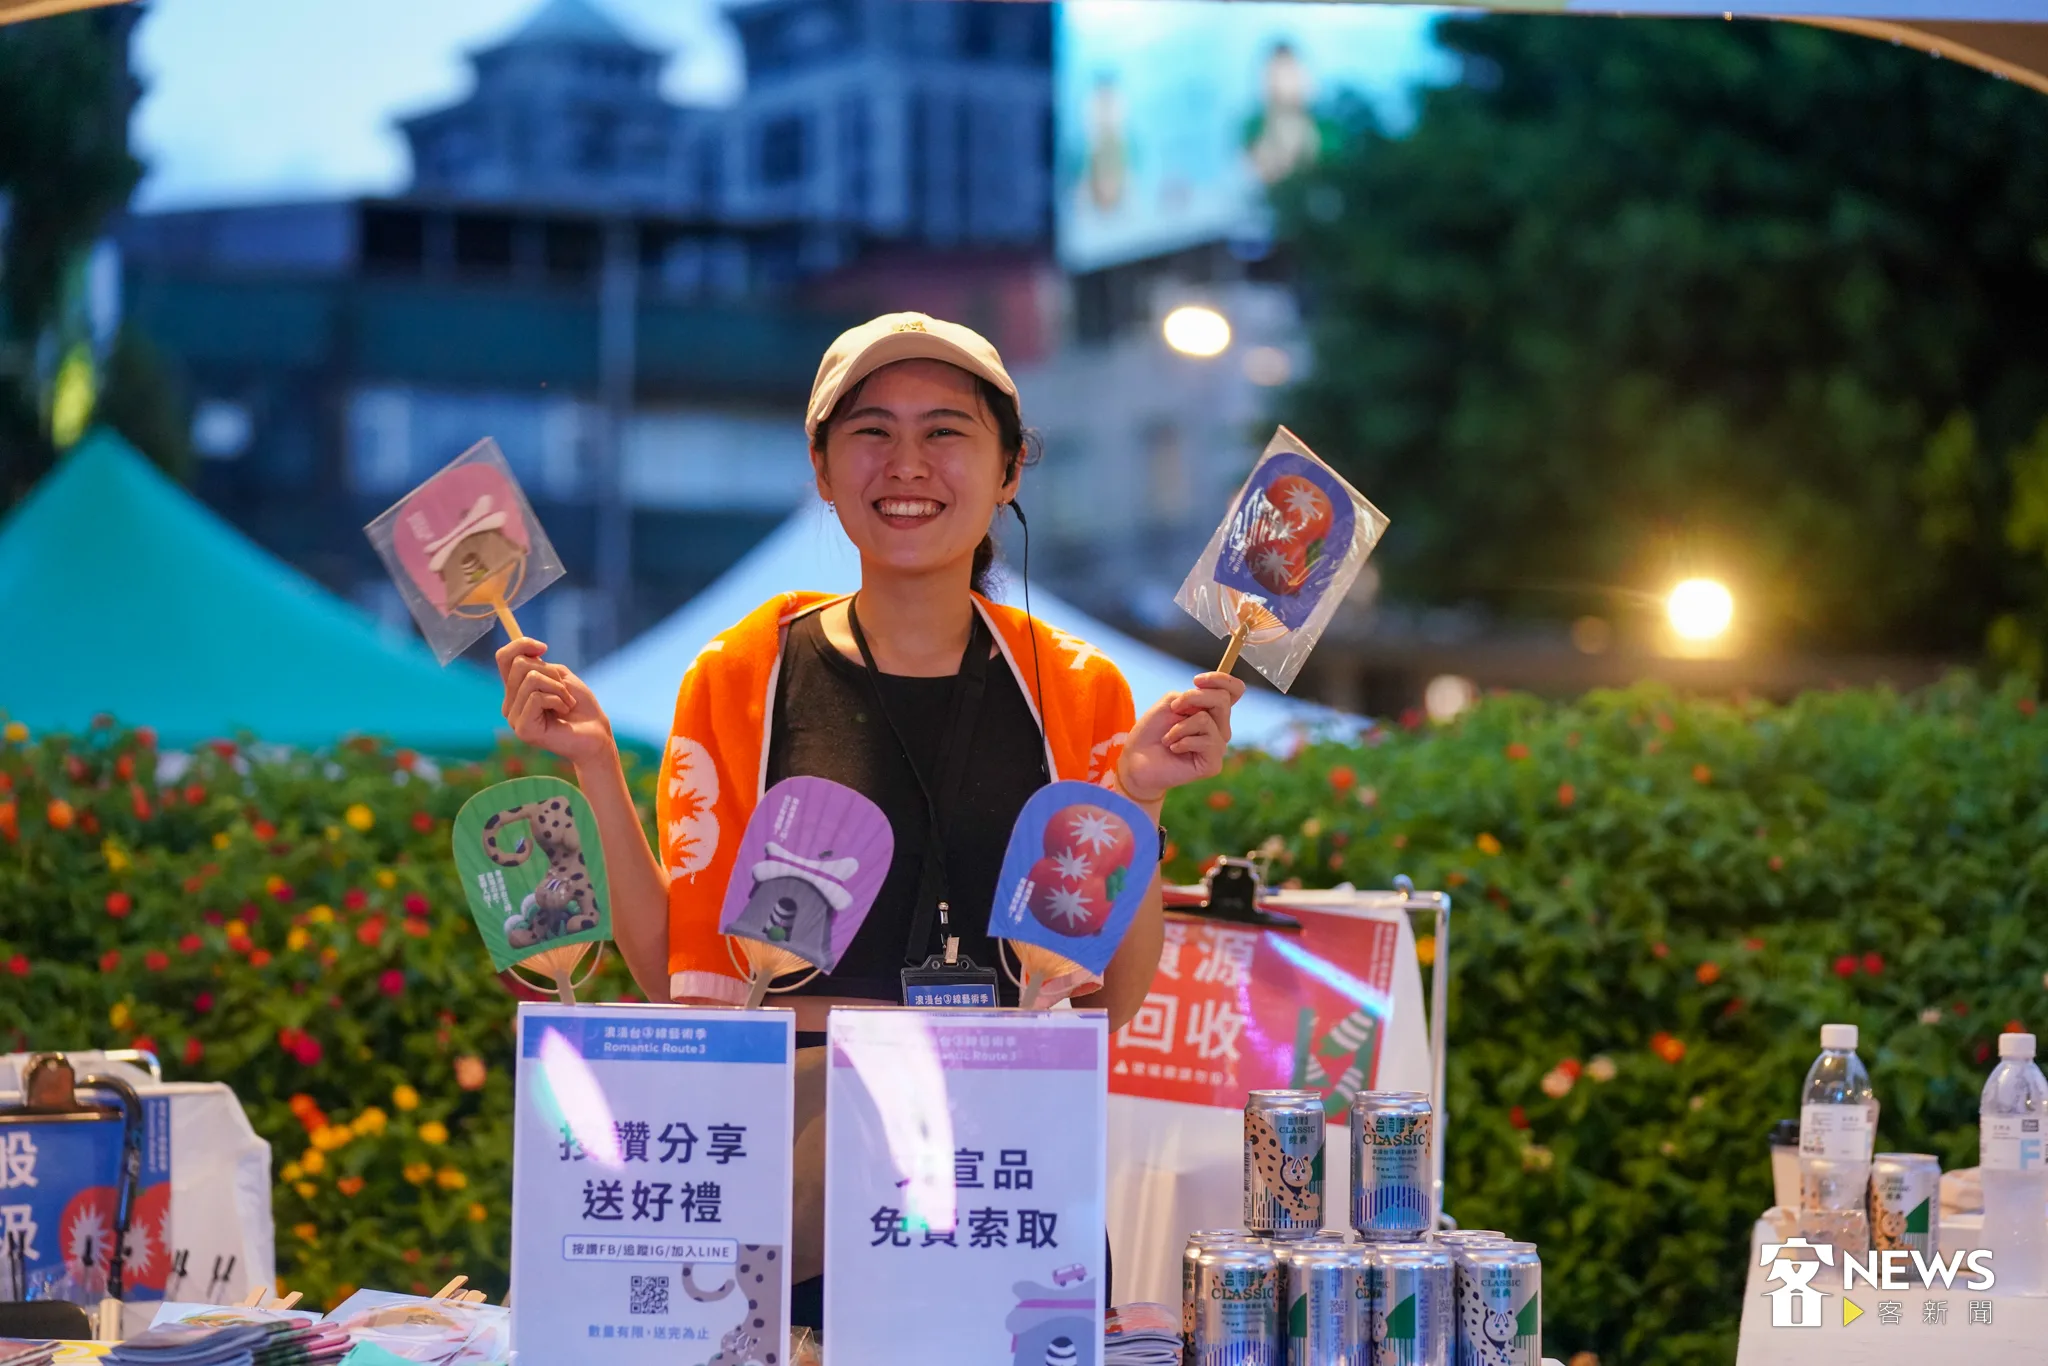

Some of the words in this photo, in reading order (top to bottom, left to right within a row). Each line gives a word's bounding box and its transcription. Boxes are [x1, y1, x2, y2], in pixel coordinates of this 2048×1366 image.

[1116, 994, 1246, 1061] 回收
[604, 1042, 659, 1054] Romantic
[662, 1043, 698, 1054] Route
[1279, 1126, 1316, 1134] CLASSIC
[1363, 1133, 1426, 1146] CLASSIC
[895, 1148, 1033, 1190] 宣品
[582, 1179, 722, 1222] 送好禮
[1481, 1279, 1521, 1287] CLASSIC
[1212, 1287, 1275, 1300] CLASSIC
